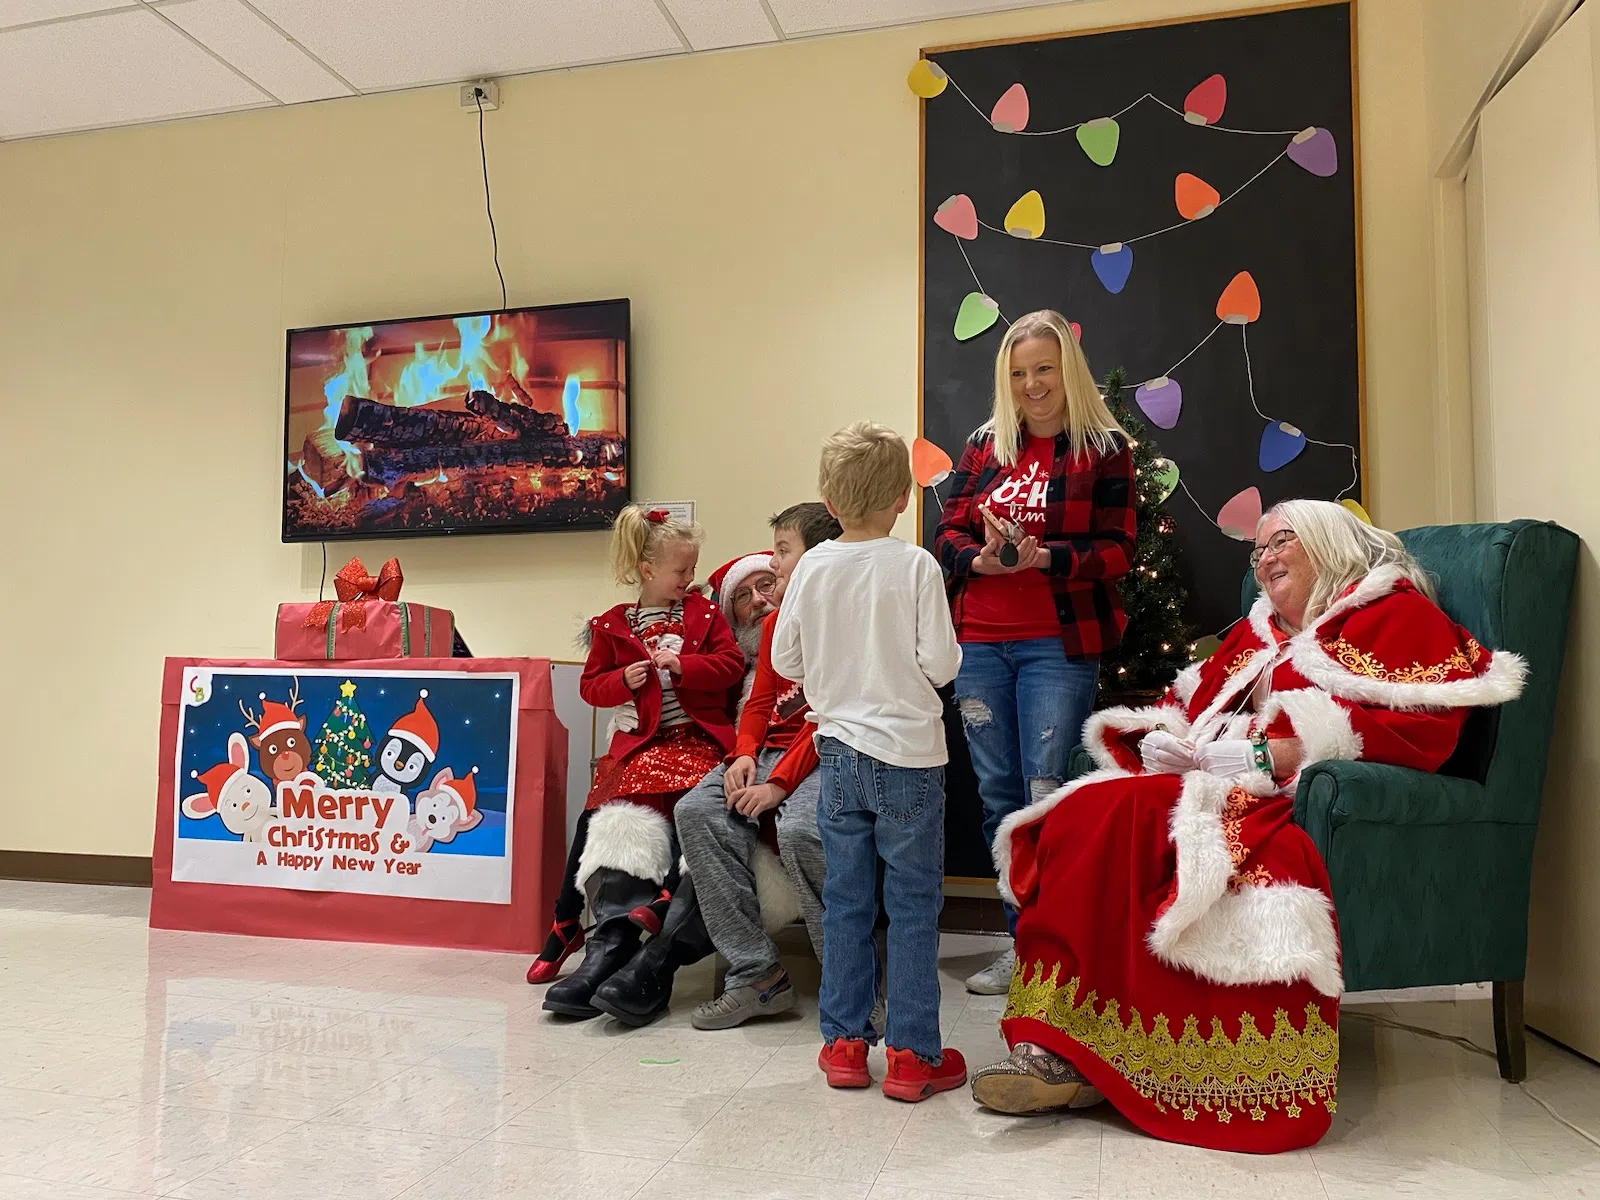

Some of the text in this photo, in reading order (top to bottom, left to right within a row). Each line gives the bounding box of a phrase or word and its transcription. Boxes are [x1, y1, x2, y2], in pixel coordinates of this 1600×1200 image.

[1004, 501, 1046, 522] tim
[282, 788, 395, 829] Merry
[268, 825, 411, 855] Christmas &
[256, 850, 422, 876] A Happy New Year
